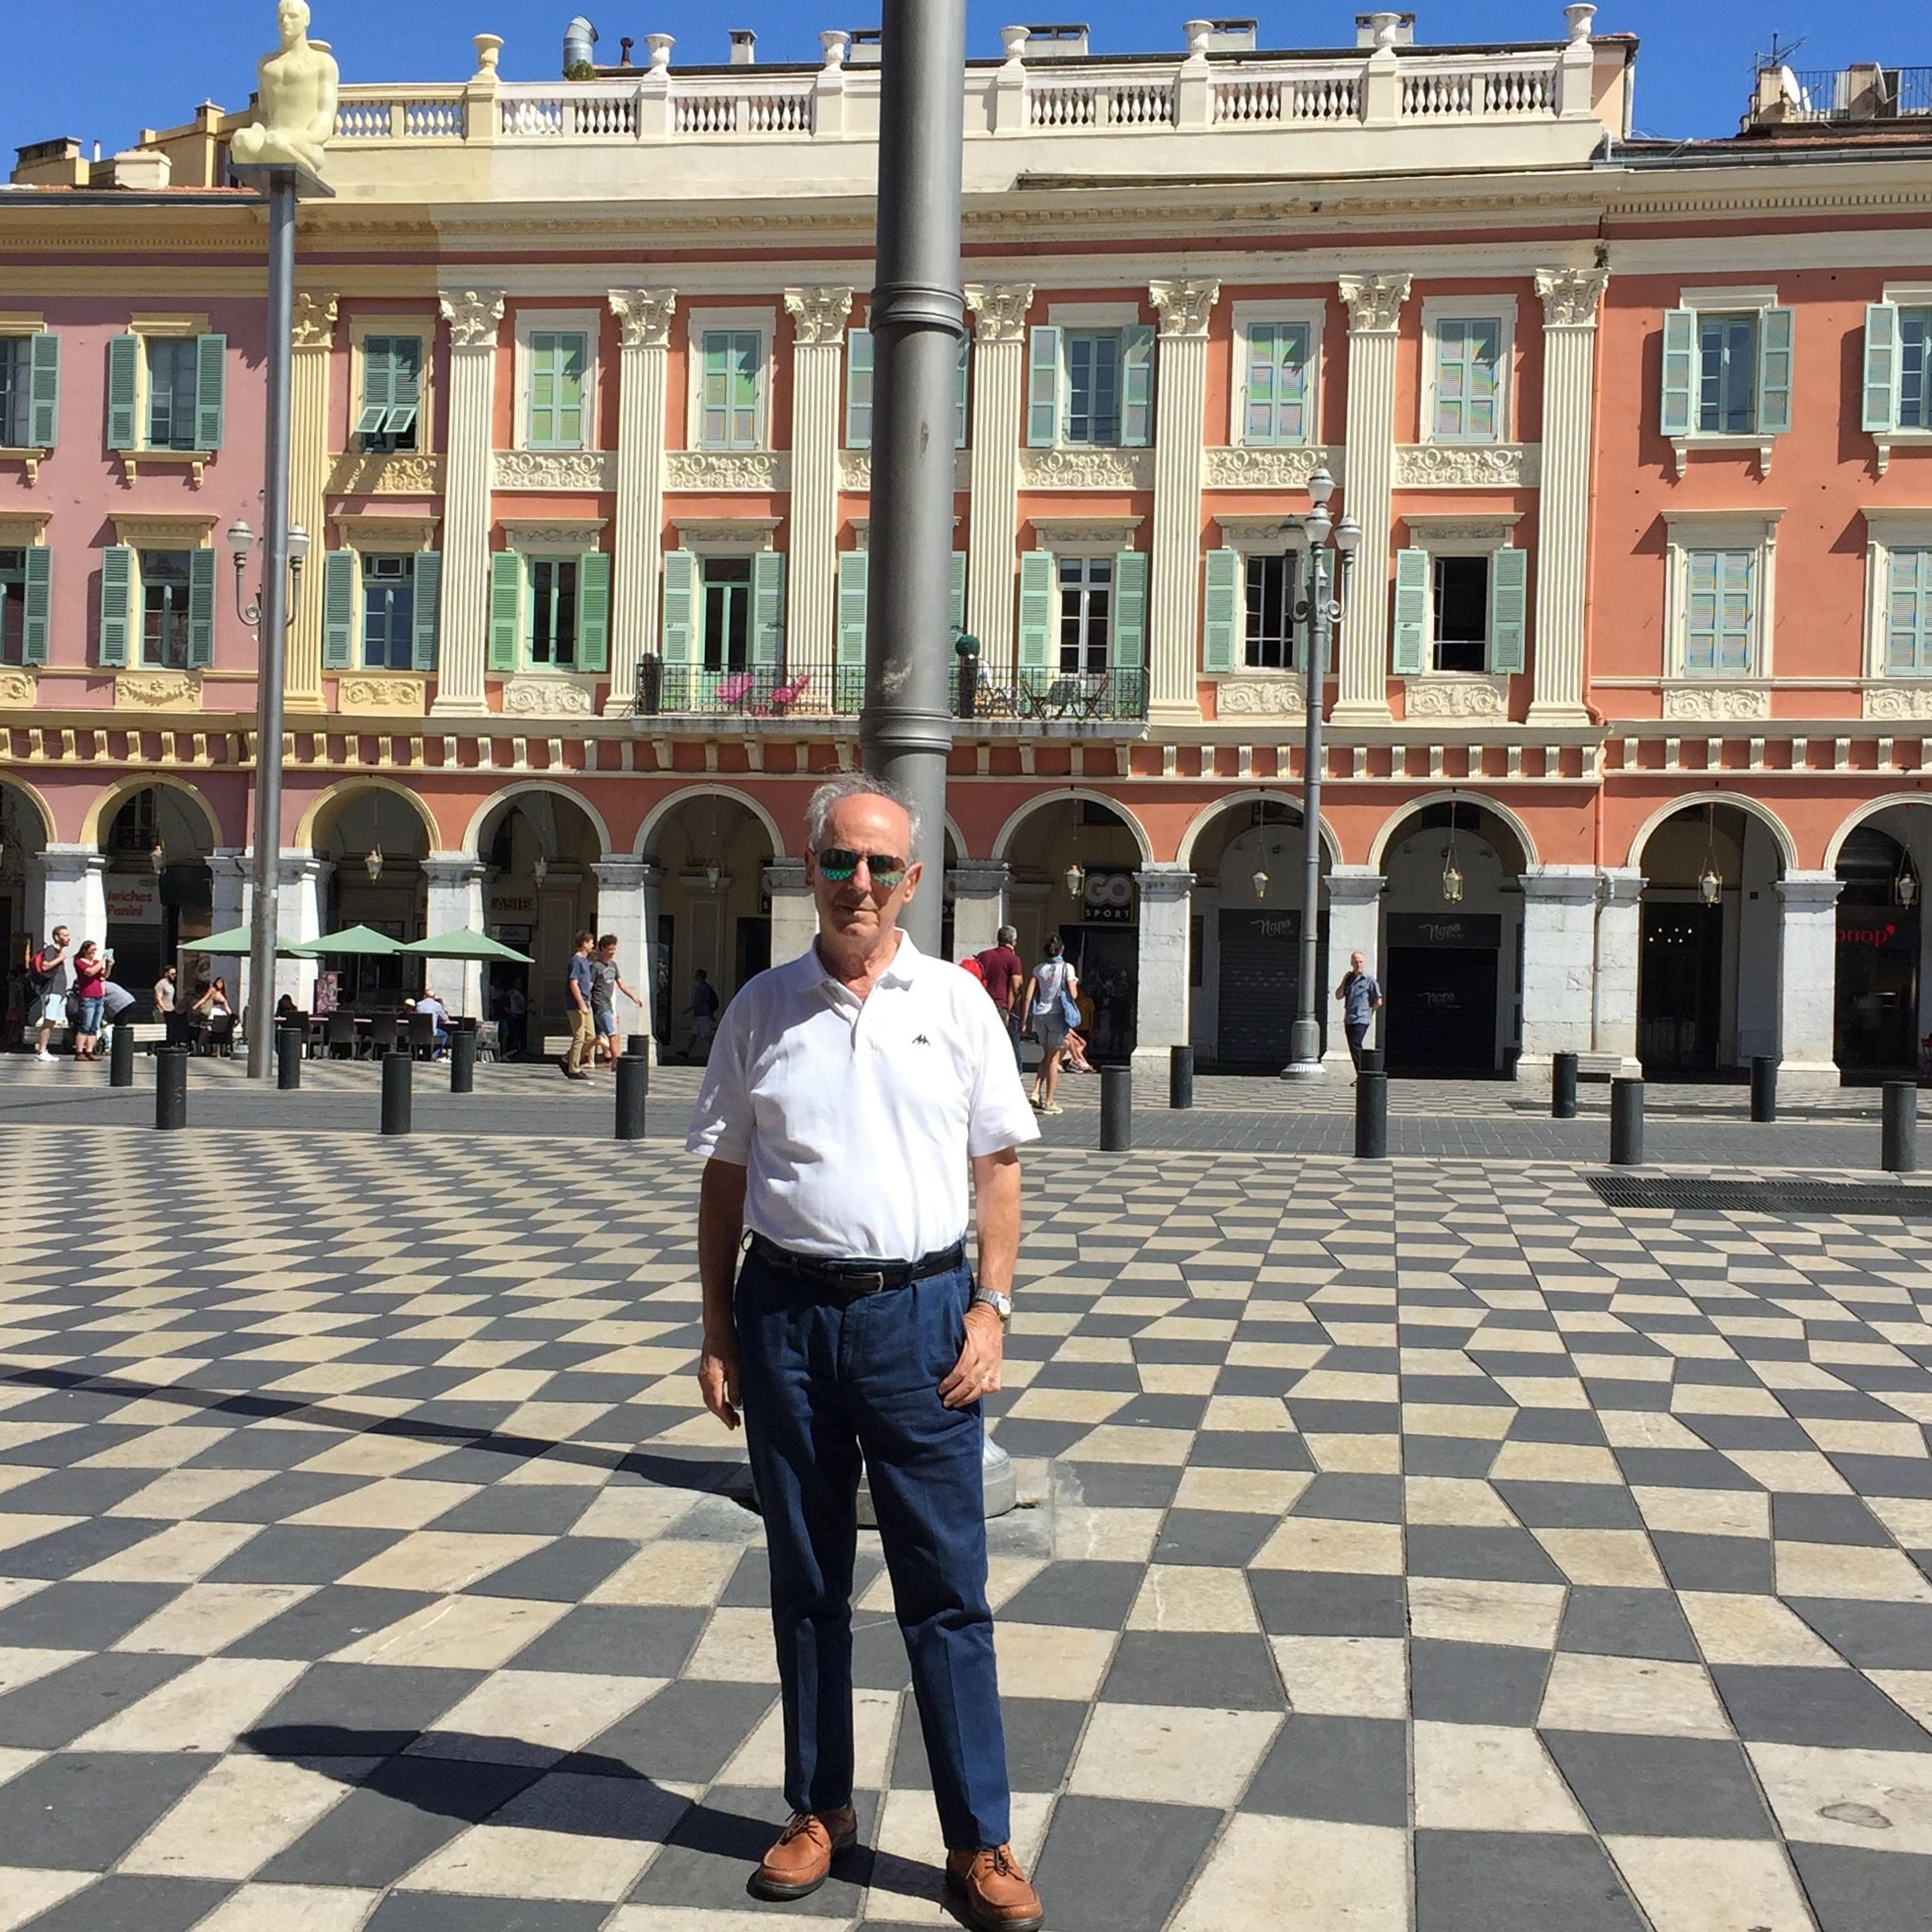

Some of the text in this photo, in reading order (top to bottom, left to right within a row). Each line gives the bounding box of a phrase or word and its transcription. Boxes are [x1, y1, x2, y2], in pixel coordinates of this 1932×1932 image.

[1085, 873, 1131, 906] GO
[107, 905, 143, 916] Panini
[1085, 909, 1129, 917] SPORT
